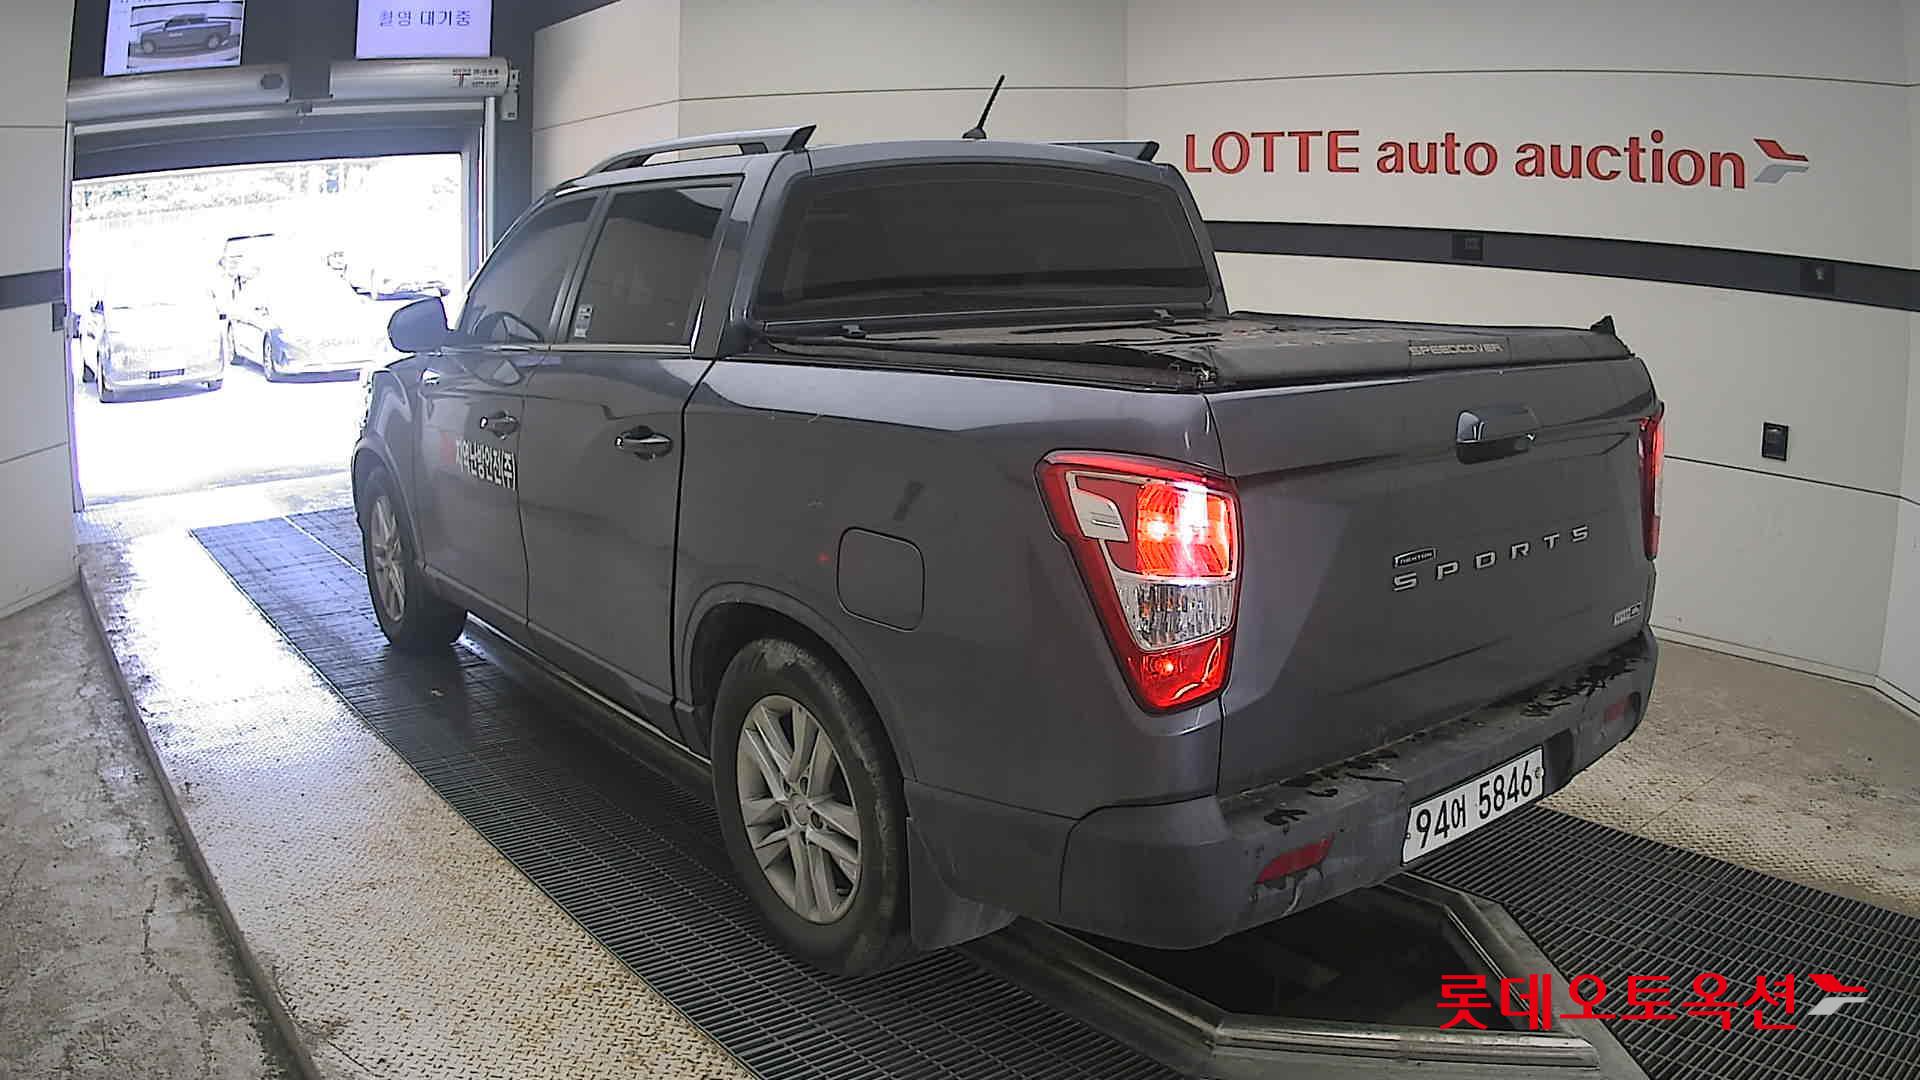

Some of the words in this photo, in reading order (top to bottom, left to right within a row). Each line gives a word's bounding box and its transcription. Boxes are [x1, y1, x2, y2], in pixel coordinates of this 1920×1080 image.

[420, 10, 470, 27] 대기중
[1185, 130, 1360, 175] LOTTE
[1376, 131, 1499, 176] auto
[1515, 130, 1746, 190] auction
[1408, 343, 1504, 356] SPEEDCOVER
[1393, 525, 1589, 592] SPORTS
[1415, 794, 1467, 849] 94어
[1478, 760, 1533, 820] 5846
